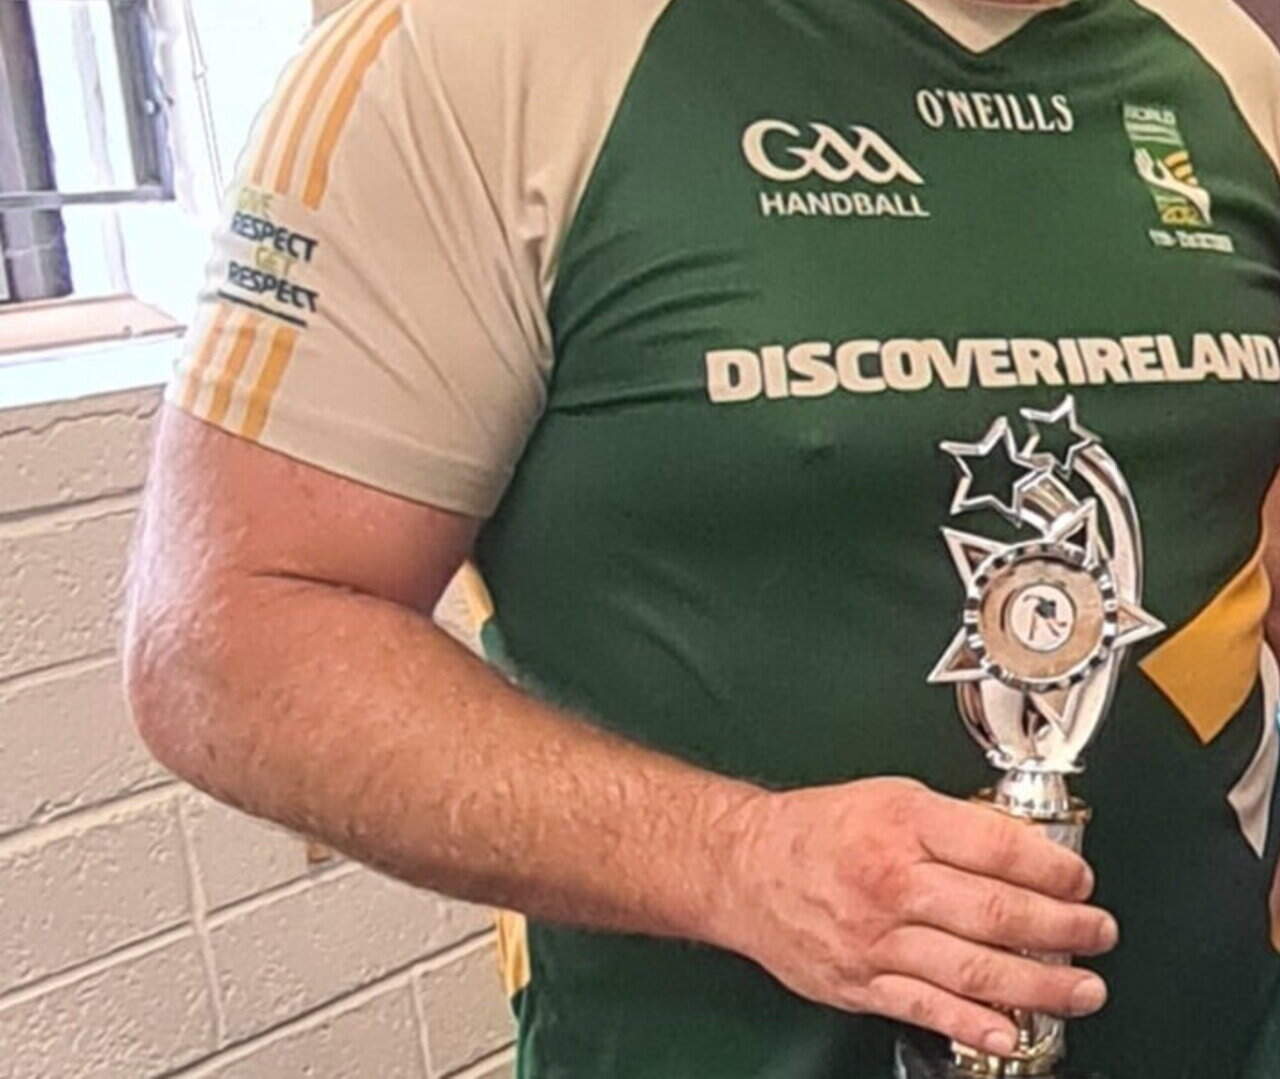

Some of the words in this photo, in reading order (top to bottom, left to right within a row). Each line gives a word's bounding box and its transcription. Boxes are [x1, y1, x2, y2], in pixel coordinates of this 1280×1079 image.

[915, 89, 1075, 133] O'NEILLS
[741, 118, 925, 186] GAA
[759, 191, 931, 219] HANDBALL
[230, 210, 319, 263] RESPECT
[228, 260, 319, 313] RESPECT
